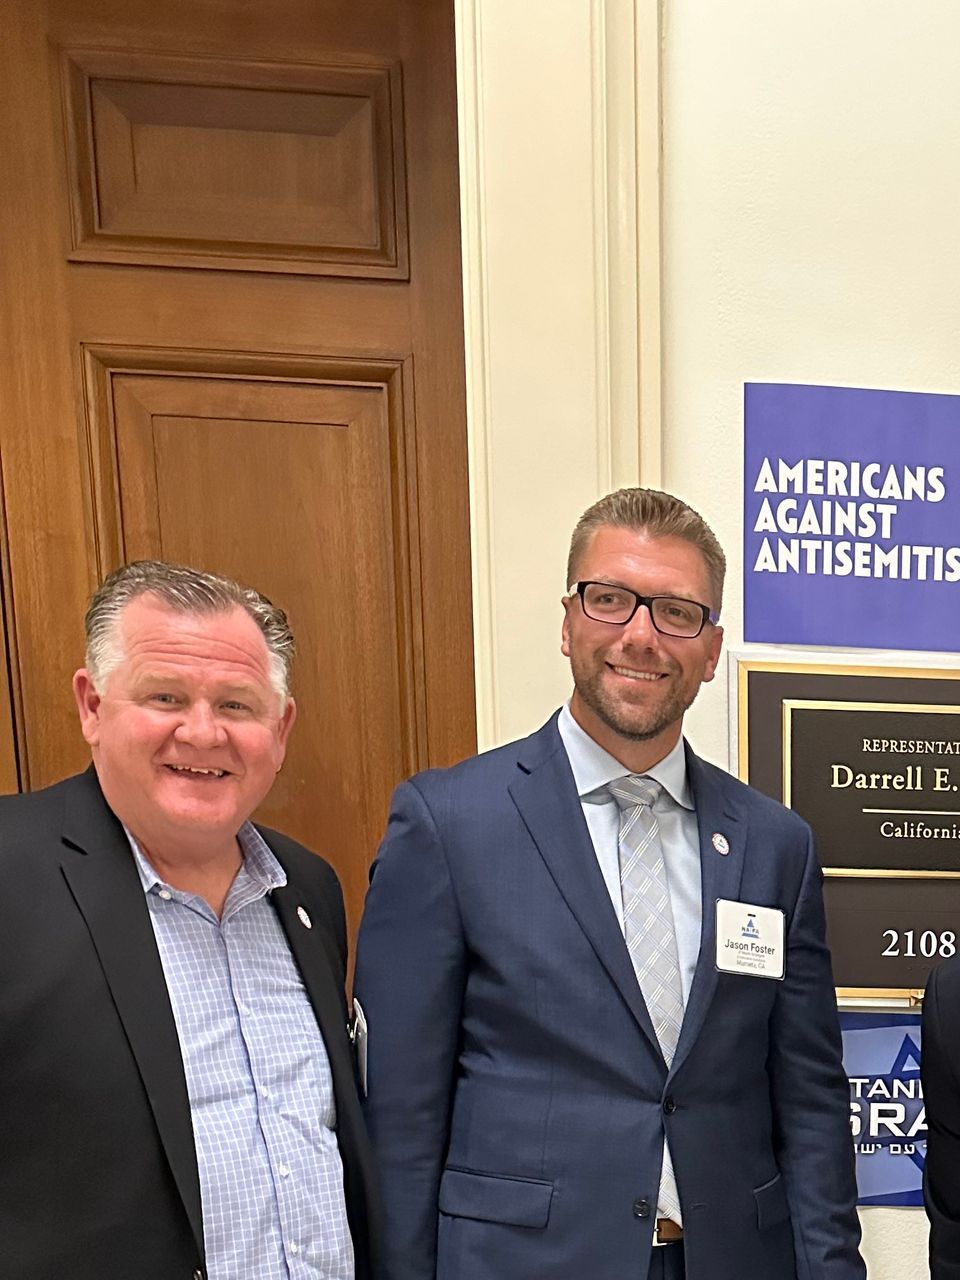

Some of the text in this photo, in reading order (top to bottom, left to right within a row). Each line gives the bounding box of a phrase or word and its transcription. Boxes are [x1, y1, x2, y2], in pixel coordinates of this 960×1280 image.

[754, 457, 945, 502] AMERICANS
[754, 497, 897, 539] AGAINST
[831, 765, 923, 791] Darrell
[933, 769, 958, 792] E.
[724, 939, 749, 951] Jason
[751, 943, 775, 955] Foster
[881, 929, 956, 957] 2108
[889, 1144, 915, 1155] עם
